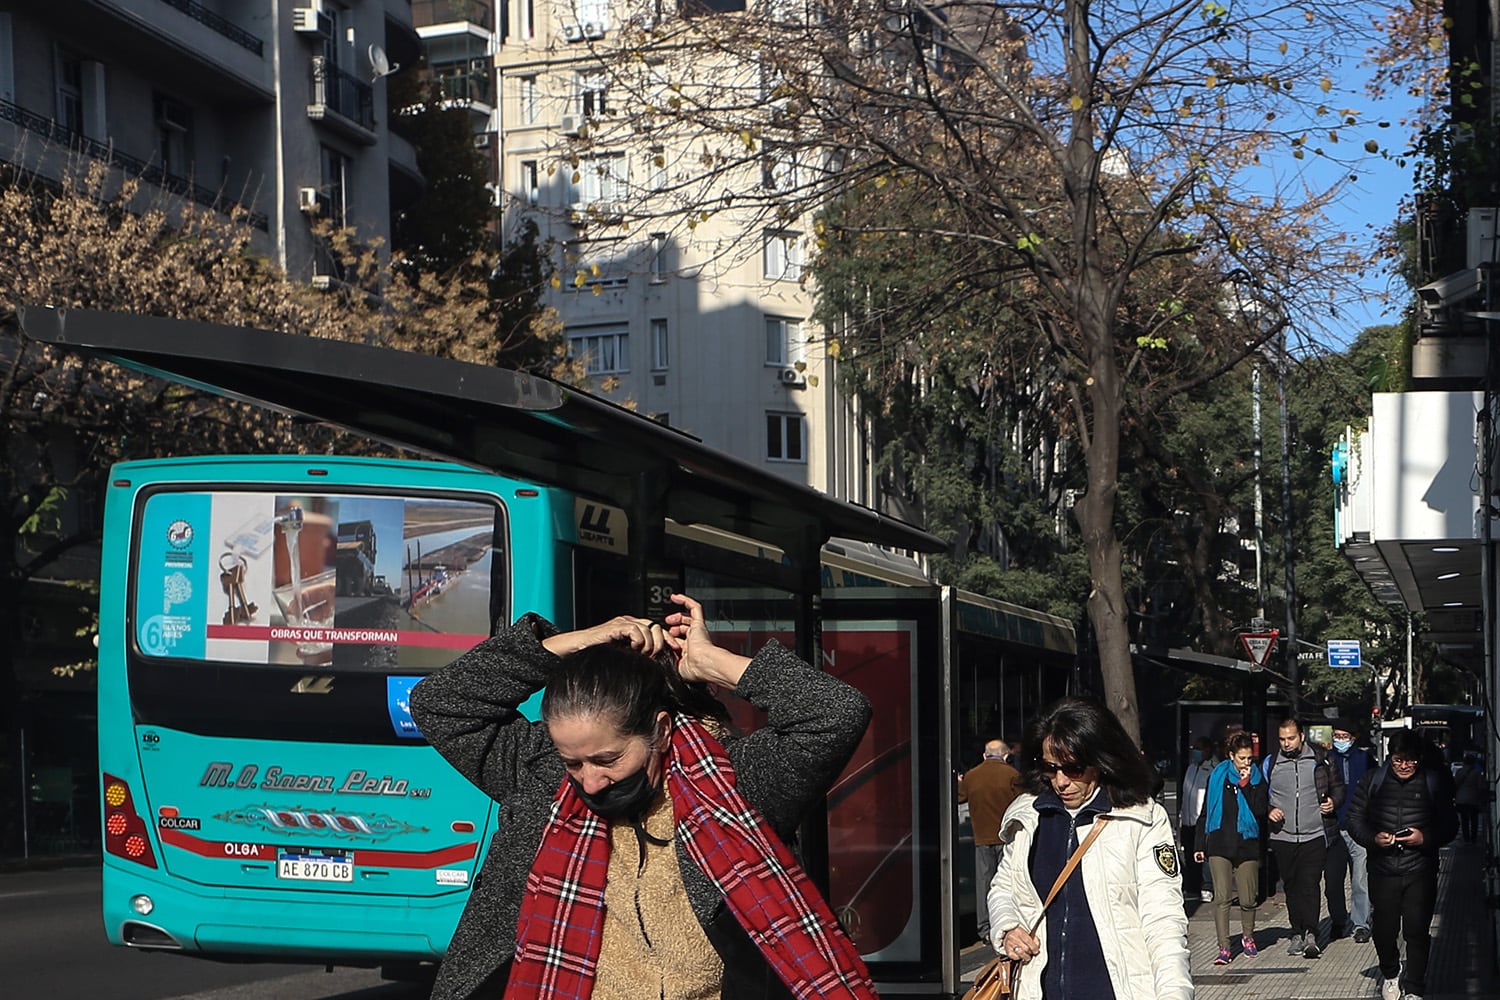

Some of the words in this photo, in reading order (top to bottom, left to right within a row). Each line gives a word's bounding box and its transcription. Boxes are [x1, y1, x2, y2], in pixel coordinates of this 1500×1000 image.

[271, 628, 301, 640] OBRAS
[303, 629, 323, 641] QUE
[325, 630, 397, 642] TRANSFORMAN
[143, 734, 160, 742] ISO
[337, 770, 409, 797] Peña
[160, 818, 198, 828] COLCAR
[283, 861, 299, 876] AE
[304, 863, 328, 877] 870
[333, 864, 349, 879] CB
